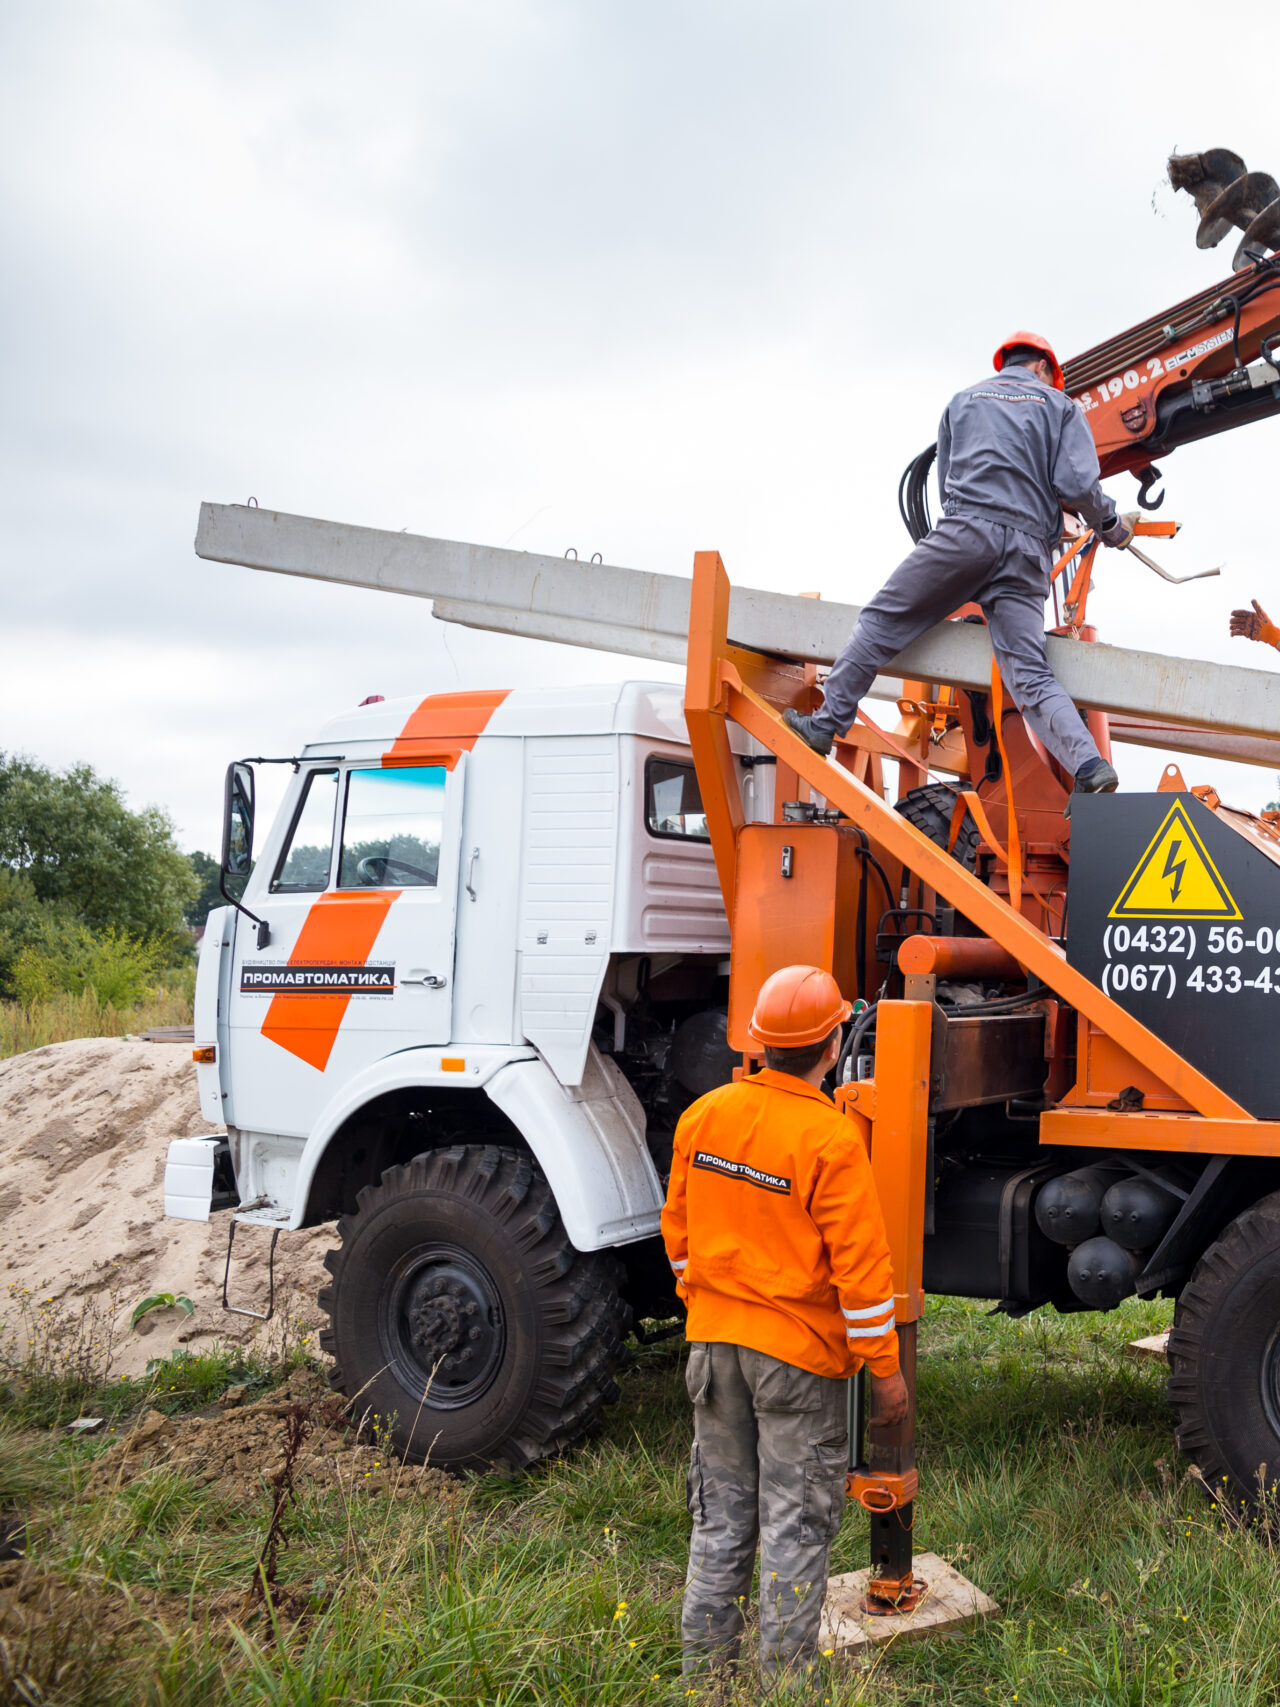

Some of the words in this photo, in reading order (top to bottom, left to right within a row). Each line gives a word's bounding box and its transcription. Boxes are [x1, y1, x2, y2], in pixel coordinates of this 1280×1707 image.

[1097, 357, 1164, 402] 190.2
[1102, 924, 1196, 960] (0432)
[243, 972, 391, 985] ПРОМАВТОМАТИКА
[1101, 963, 1177, 999] (067)
[697, 1153, 787, 1187] ПРОМАВТОМАТИКА
